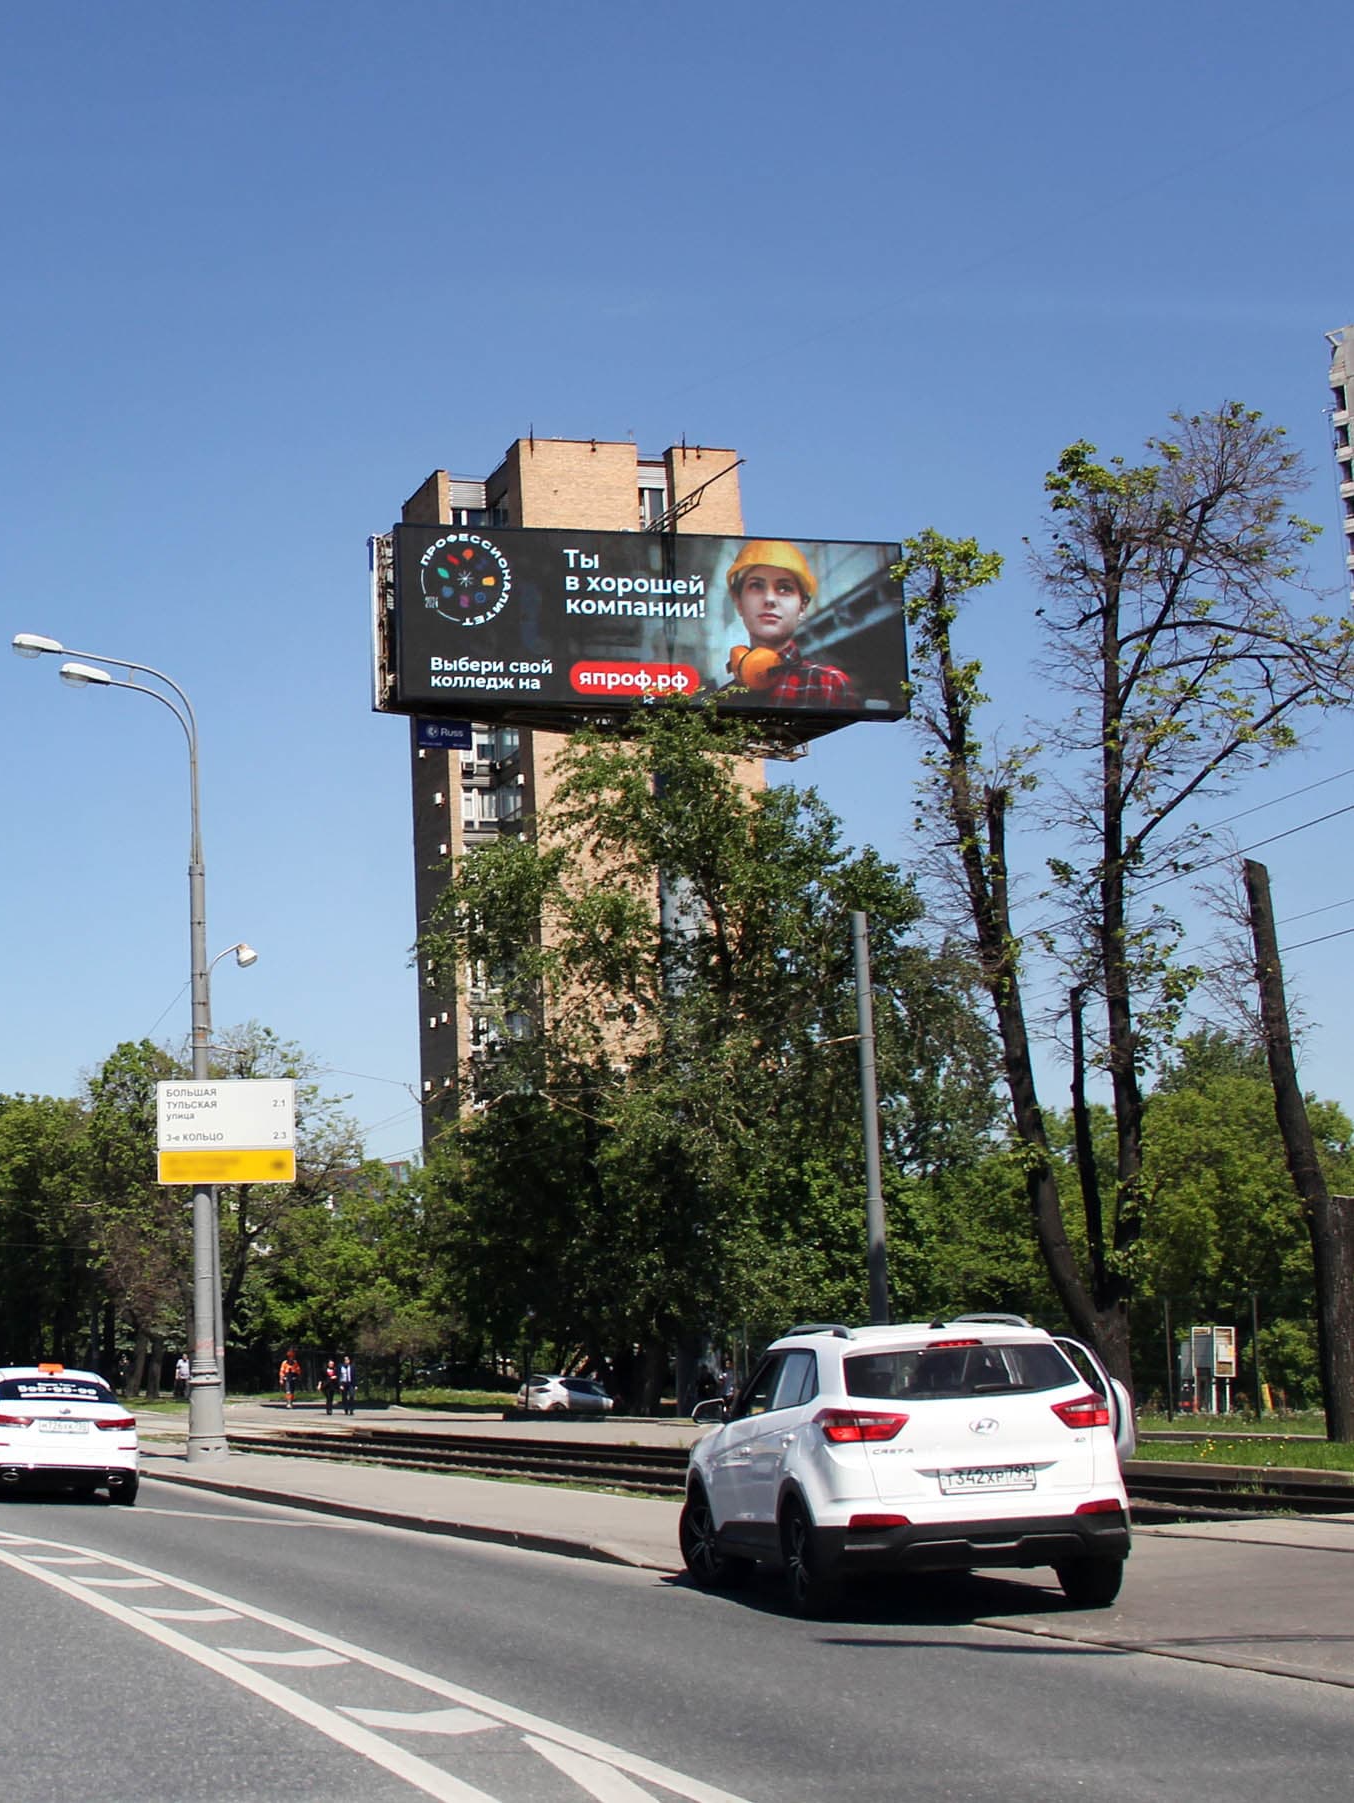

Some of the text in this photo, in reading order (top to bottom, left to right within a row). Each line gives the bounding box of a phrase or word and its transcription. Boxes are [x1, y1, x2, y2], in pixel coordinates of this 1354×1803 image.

[563, 549, 599, 569] Ты
[420, 533, 512, 626] ПРОФЕССИОНАЛИТЕТ
[565, 575, 705, 597] в хорошей
[566, 598, 706, 618] компании!
[430, 657, 553, 675] Выбери свой
[431, 675, 541, 690] колледж на
[579, 669, 689, 692] япроф.рф
[440, 727, 464, 738] Russ
[166, 1088, 217, 1098] БОЛЬШАЯ
[166, 1100, 217, 1110] ТУЛЬСКАЯ
[272, 1099, 286, 1108] 2.1
[166, 1112, 195, 1121] улица
[182, 1132, 224, 1143] КОЛЬЦО
[272, 1131, 287, 1140] 2.3
